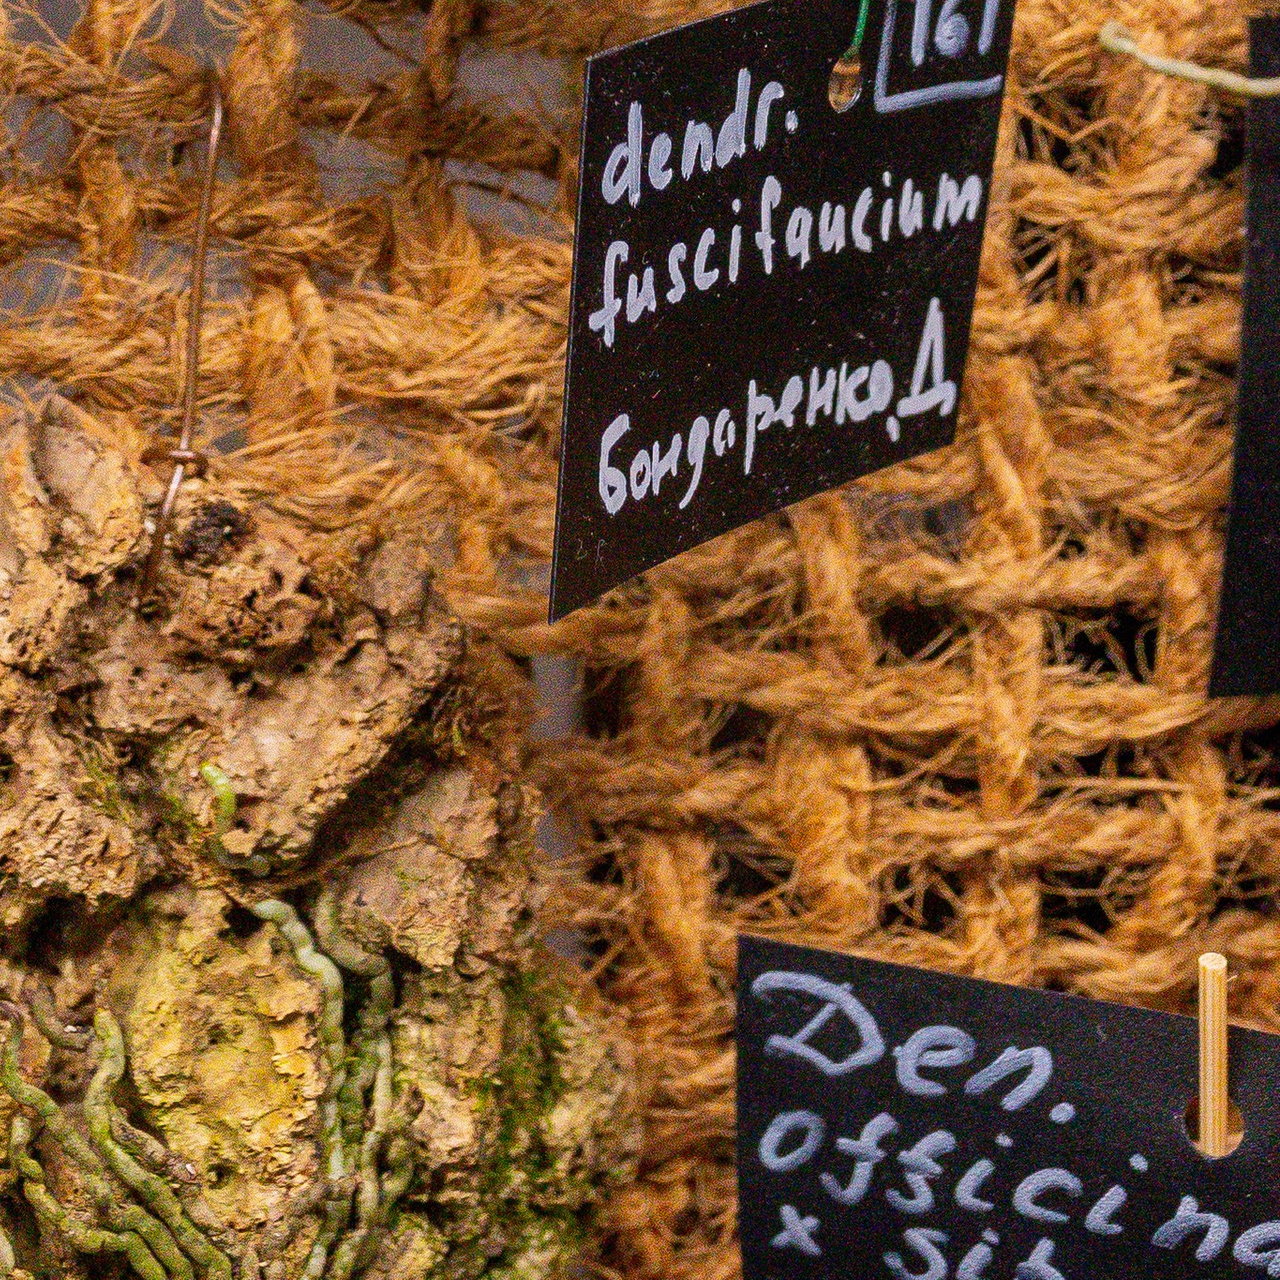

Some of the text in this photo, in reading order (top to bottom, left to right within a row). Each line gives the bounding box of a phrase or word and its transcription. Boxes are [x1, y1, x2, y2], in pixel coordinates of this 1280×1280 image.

[601, 67, 798, 208] dendr.
[588, 171, 982, 348] fuscifaucium
[751, 970, 1077, 1126] Den.
